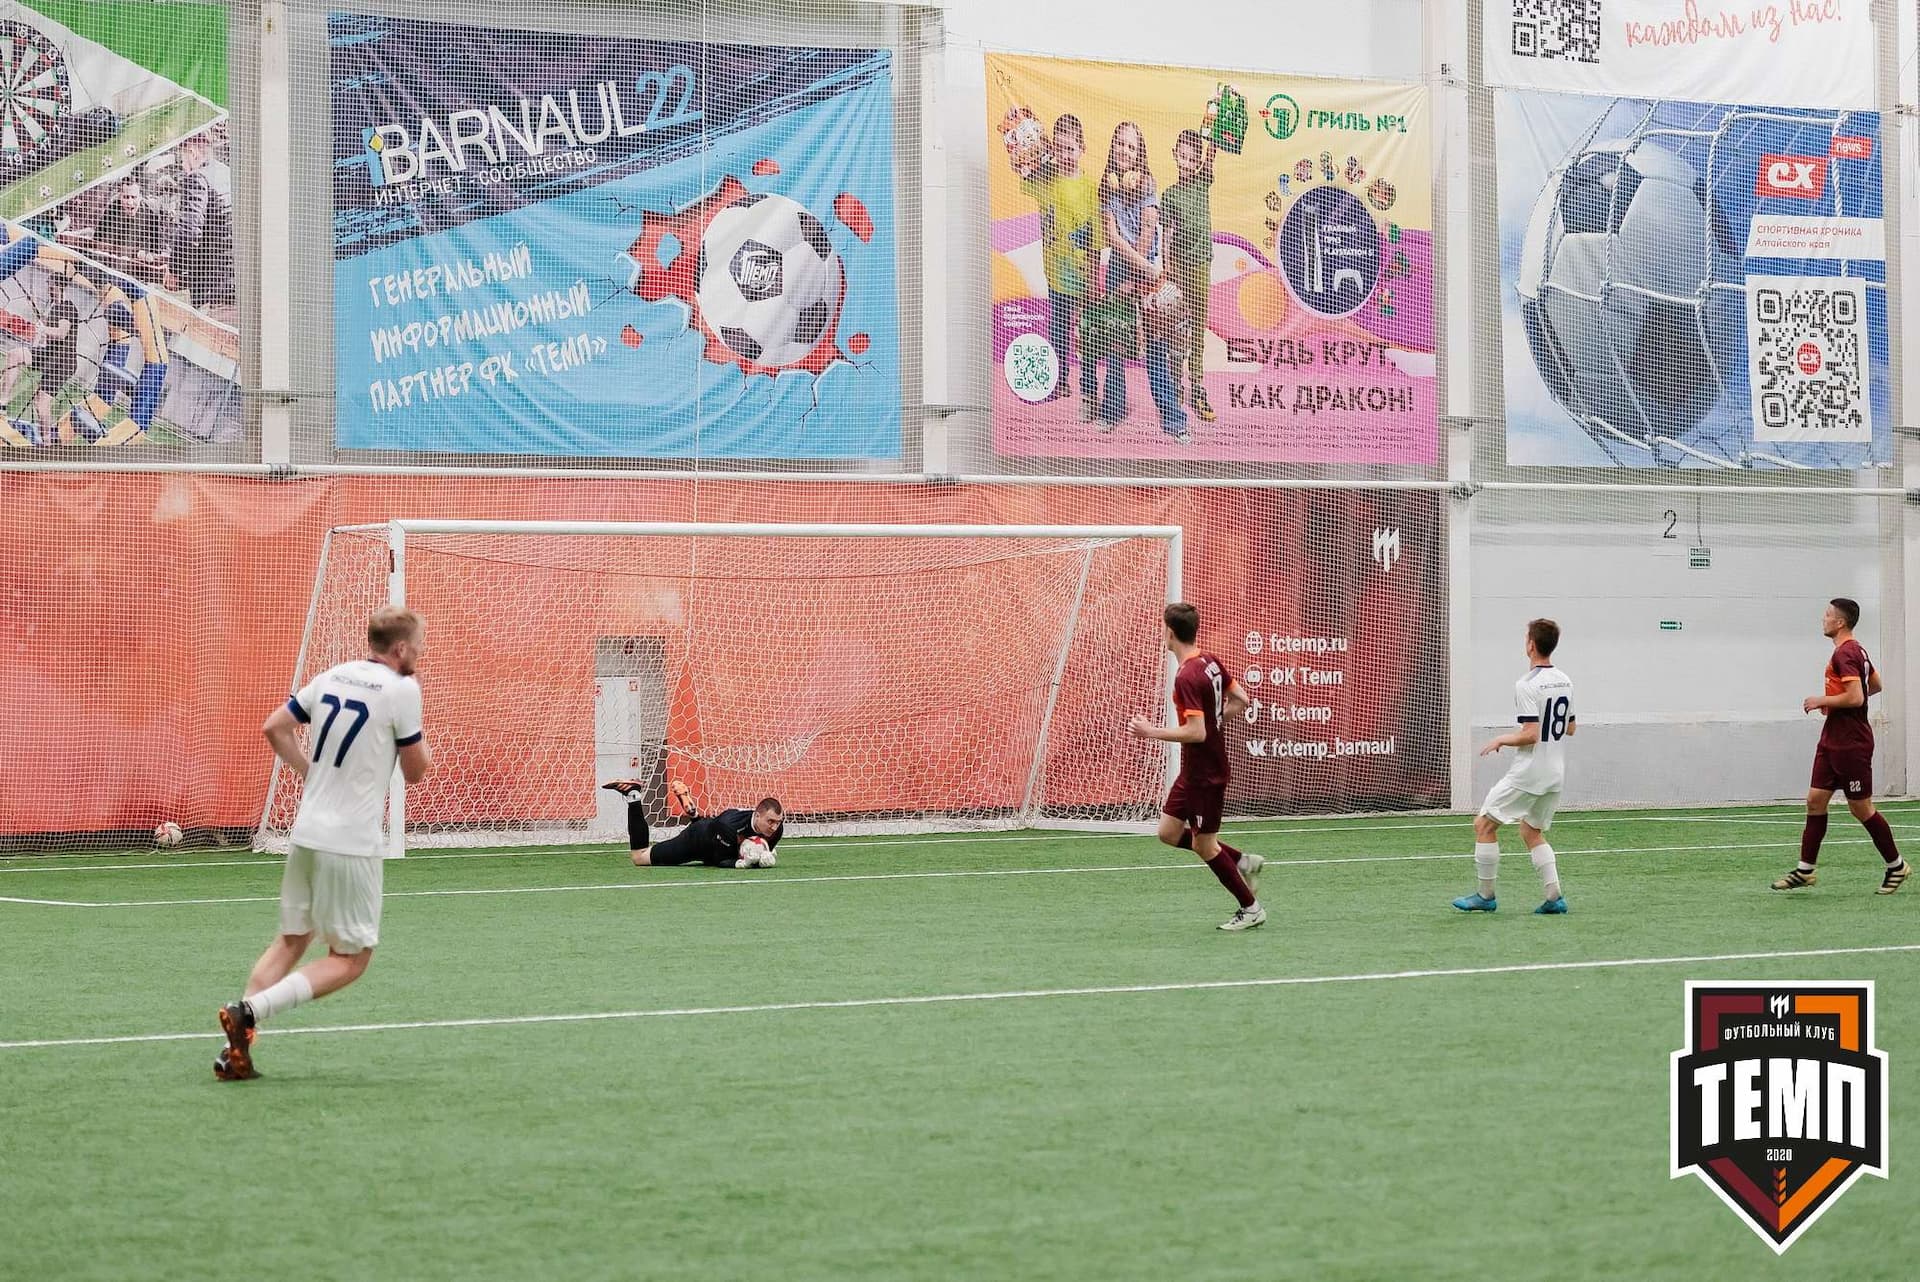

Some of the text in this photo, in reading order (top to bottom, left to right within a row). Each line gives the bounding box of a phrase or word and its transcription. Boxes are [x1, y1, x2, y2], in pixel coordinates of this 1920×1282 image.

[1307, 110, 1371, 132] ГРИЛЬ
[1836, 142, 1862, 153] news
[374, 174, 463, 206] ИНТЕРНЕТ
[479, 147, 597, 186] СООБЩЕСТВО
[1756, 225, 1863, 237] СПОРТИВНАЯ ХРОНИКА
[368, 239, 532, 308] ГЕНЕРАЛЬНЫЙ
[370, 279, 593, 364] ИНФОРМАЦИОННЫЙ
[1226, 337, 1398, 373] БУДЬ КРУТ,
[369, 333, 608, 415] ПАРТНЕР ФК «ТЕМП»
[1228, 383, 1415, 416] КАК ДРАКОН!
[1663, 508, 1678, 540] 2
[1270, 633, 1348, 656] fctemp.ru
[1270, 667, 1343, 686] ФК Темп
[312, 693, 370, 768] 77
[1541, 696, 1569, 742] 18
[1271, 736, 1395, 761] fctemp_barnaul
